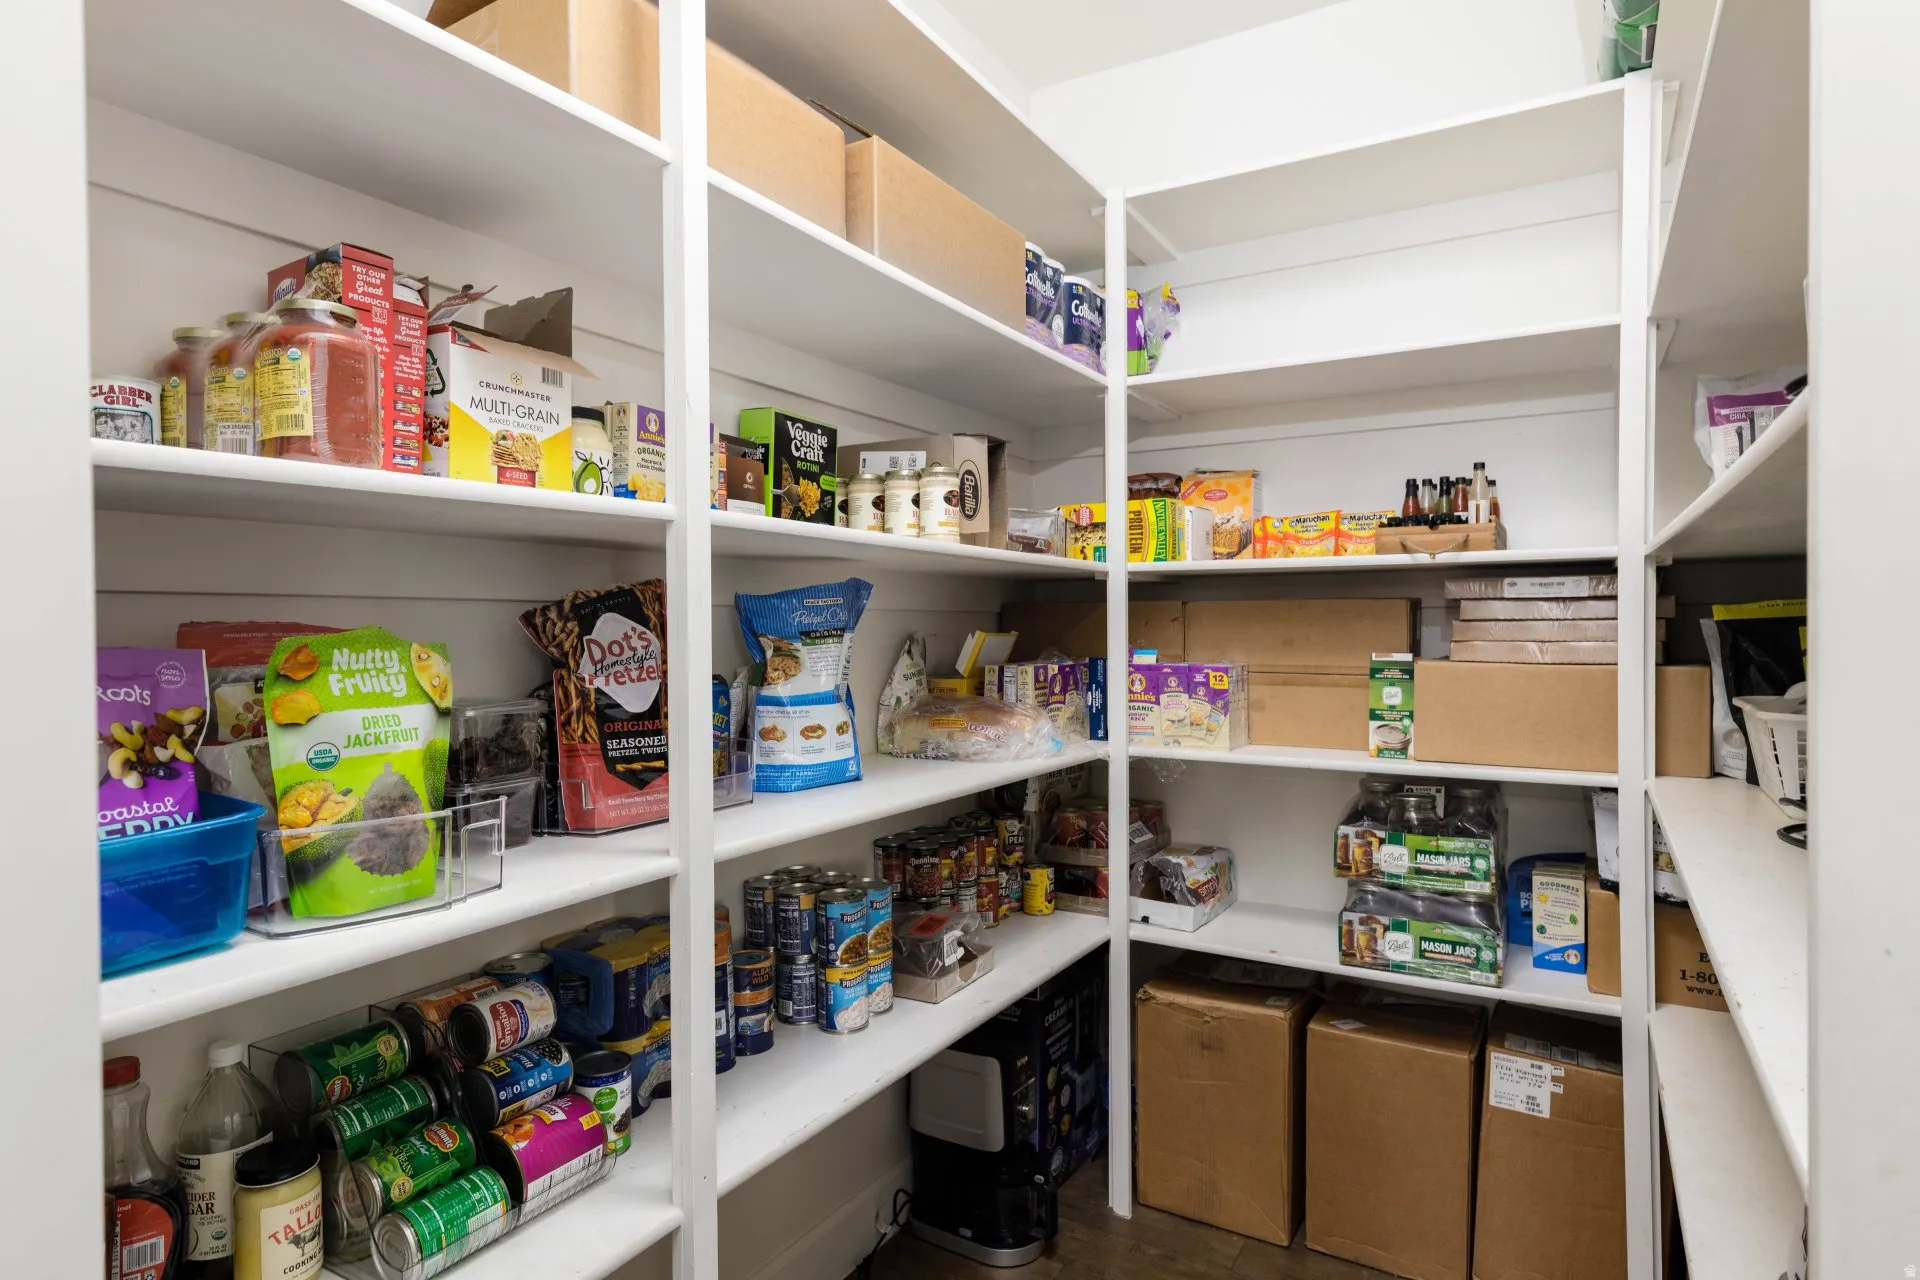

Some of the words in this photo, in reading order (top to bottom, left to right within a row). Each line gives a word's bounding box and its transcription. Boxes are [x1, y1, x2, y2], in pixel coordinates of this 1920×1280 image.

[352, 264, 366, 274] TRY
[368, 270, 386, 280] OUR
[356, 273, 381, 284] OTHER
[355, 280, 384, 296] Great
[348, 292, 390, 308] PRODUCTS
[90, 384, 152, 404] CLABBER
[479, 380, 552, 402] CRUNCHMASTER
[104, 396, 139, 408] GIRL
[470, 395, 560, 426] MULTI-GRAIN
[488, 416, 510, 426] BAKED
[512, 421, 544, 432] CRACKERS
[638, 430, 666, 446] Annie's
[786, 420, 828, 448] Veggie
[637, 448, 666, 460] ORGANIC
[791, 440, 825, 463] Craft
[797, 460, 820, 473] ROTINI
[506, 470, 528, 480] 6-SEED
[964, 474, 975, 516] Barilla
[1154, 502, 1166, 531] NATURE
[1296, 514, 1330, 524] Maruchan
[1349, 514, 1388, 522] Maruchan
[1129, 510, 1144, 554] PROTEIN
[1154, 532, 1166, 560] VALLEY
[791, 610, 828, 628] Pretzel
[585, 626, 653, 666] Dot's
[332, 647, 400, 673] Nutty
[594, 644, 657, 674] Homestyle
[161, 668, 182, 676] non
[161, 674, 181, 682] gmo
[1212, 674, 1224, 682] 12
[328, 671, 408, 698] Fruity
[96, 684, 151, 706] Roots
[362, 713, 402, 732] DRIED
[343, 728, 420, 750] JACKFRUIT
[606, 735, 667, 750] SEASONED
[311, 756, 336, 764] ORGANIC
[313, 748, 333, 758] USDA
[608, 750, 640, 758] PRETZEL
[641, 746, 668, 754] TWISTS
[96, 796, 180, 824] oastal
[1008, 836, 1024, 844] PEA
[1416, 853, 1446, 865] MASON
[1448, 856, 1471, 867] JARS
[1540, 881, 1580, 893] GOODNESS
[843, 906, 867, 922] PROGRESS
[1388, 940, 1410, 952] Ball
[1421, 940, 1452, 954] MASON
[1454, 946, 1477, 958] JARS
[752, 974, 769, 984] WILD
[842, 972, 868, 988] PROGRESS
[496, 1003, 513, 1050] Carnation
[488, 1060, 505, 1074] BUS
[400, 1144, 414, 1156] CUT
[396, 1154, 414, 1176] BEANS
[186, 1192, 216, 1202] CIDER
[492, 1184, 502, 1200] Facts
[116, 1203, 132, 1212] inal
[206, 1218, 227, 1226] MOTHER
[268, 1204, 320, 1246] TALLO
[283, 1251, 318, 1275] COOKING
